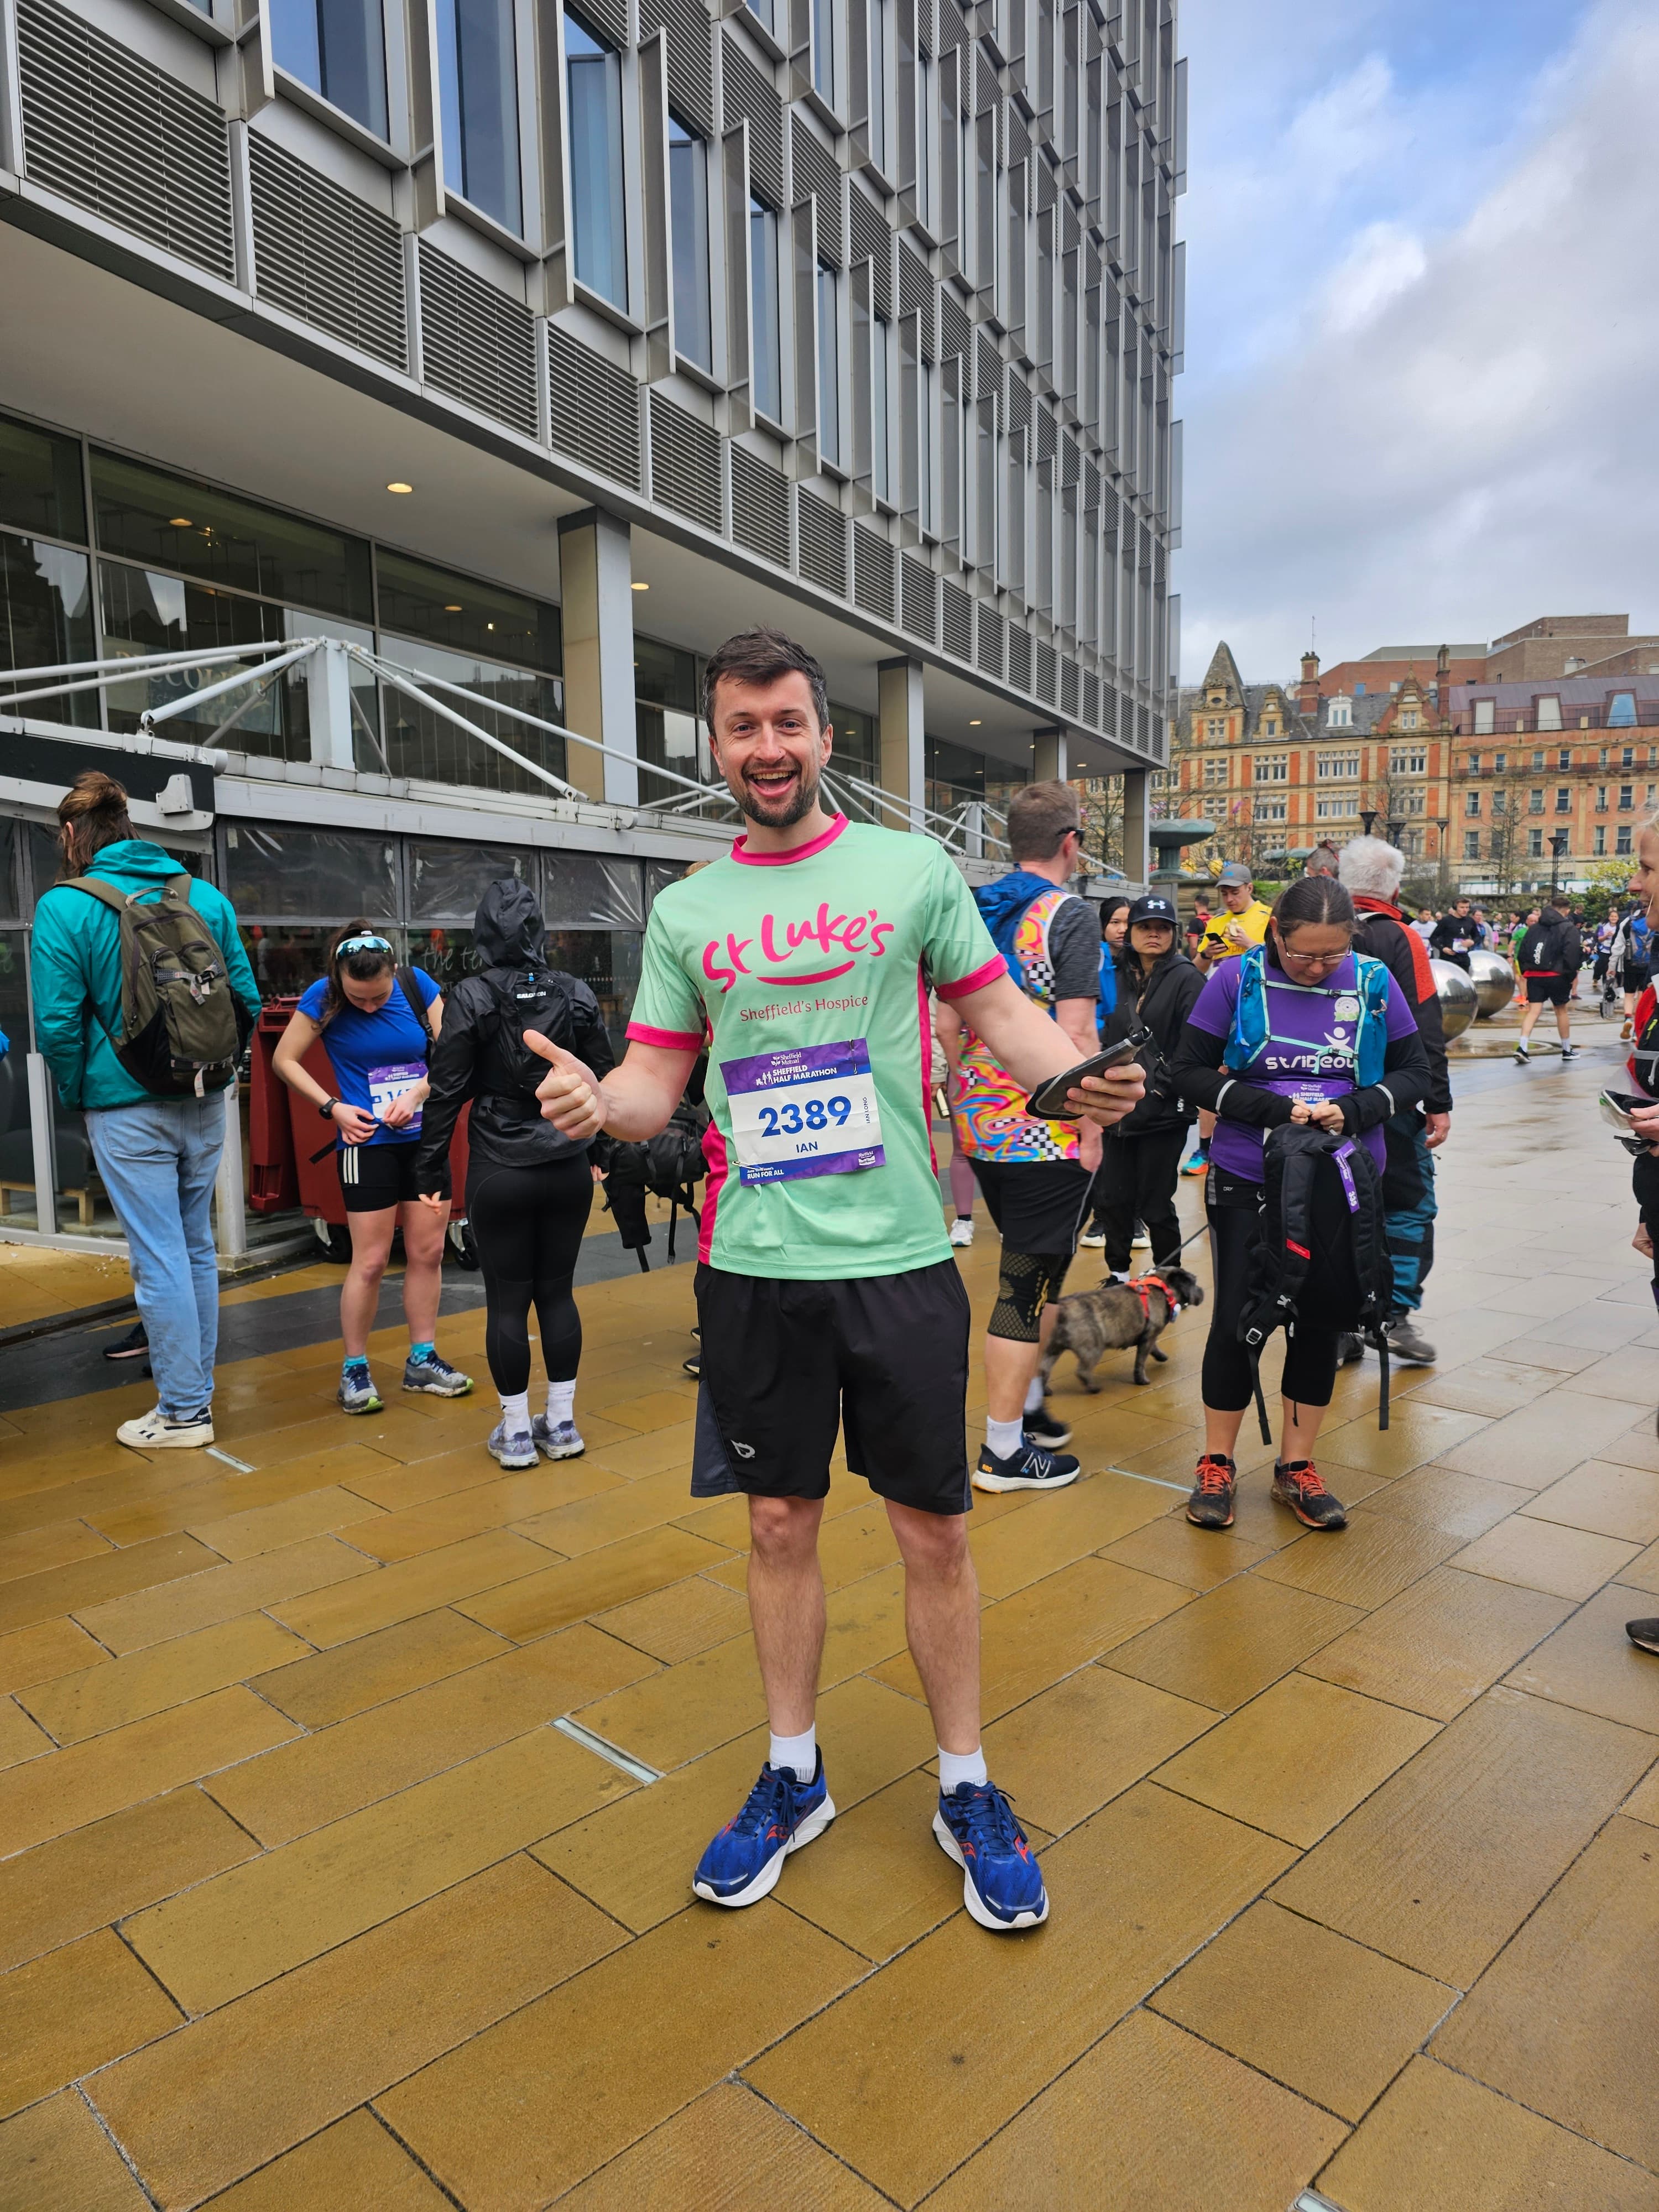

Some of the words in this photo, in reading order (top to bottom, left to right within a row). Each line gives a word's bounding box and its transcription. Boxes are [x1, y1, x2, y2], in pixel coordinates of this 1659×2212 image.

[421, 946, 453, 971] the
[702, 933, 753, 993] St
[761, 902, 894, 962] Luke's
[1533, 942, 1543, 964] adidas
[740, 1000, 812, 1021] Sheffield's
[816, 995, 869, 1012] Hospice
[780, 1052, 802, 1061] Sheffield
[773, 1065, 808, 1076] SHEFFIELD
[773, 1075, 791, 1084] HALF
[793, 1067, 837, 1081] MARATHON
[758, 1095, 852, 1137] 2389
[796, 1141, 818, 1153] IAN
